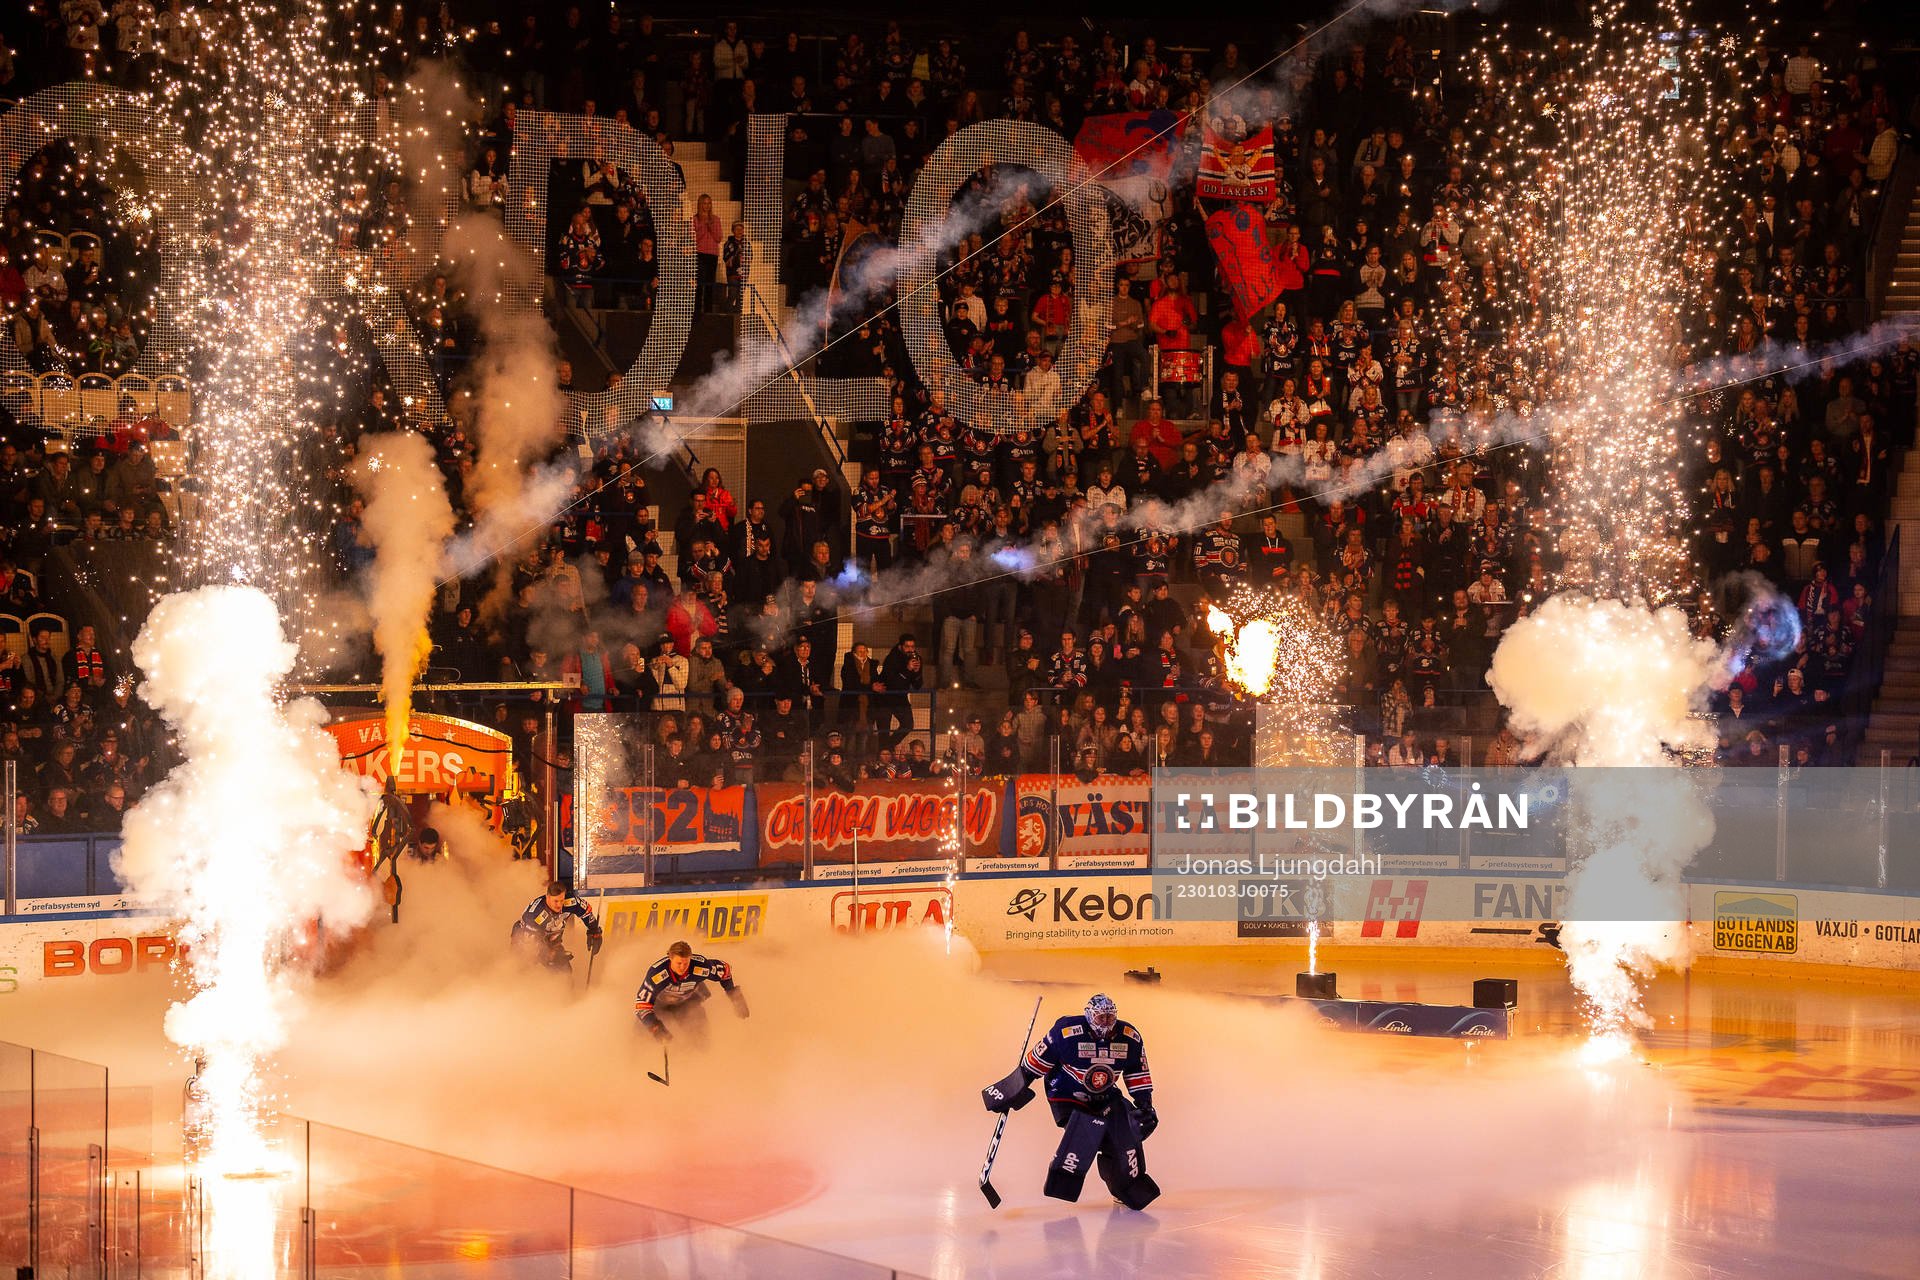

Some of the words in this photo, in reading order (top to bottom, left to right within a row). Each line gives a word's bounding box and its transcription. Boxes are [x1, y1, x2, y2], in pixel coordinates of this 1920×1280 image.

[358, 723, 423, 744] VÄÖ
[341, 750, 465, 786] AKERS
[870, 868, 882, 876] syd
[982, 862, 1026, 870] prefabsystem
[1488, 861, 1539, 869] prefabsystem
[31, 901, 86, 912] prefabsystem
[86, 901, 100, 910] syd
[1053, 885, 1173, 922] Kebni
[1717, 915, 1795, 934] GOTLANDS
[1815, 918, 1858, 938] VÄXJÖ
[1006, 929, 1044, 940] Bringing
[1045, 928, 1080, 938] stability
[1082, 928, 1092, 936] to
[1101, 927, 1125, 936] world
[1126, 927, 1138, 936] in
[1139, 927, 1174, 936] motion
[1716, 932, 1773, 950] BYGGEN
[1775, 936, 1795, 951] AB
[1378, 1020, 1413, 1033] Linde
[1461, 1025, 1496, 1037] Linde
[985, 1085, 1004, 1101] APP
[1062, 1152, 1080, 1174] APP
[1126, 1149, 1139, 1178] APP
